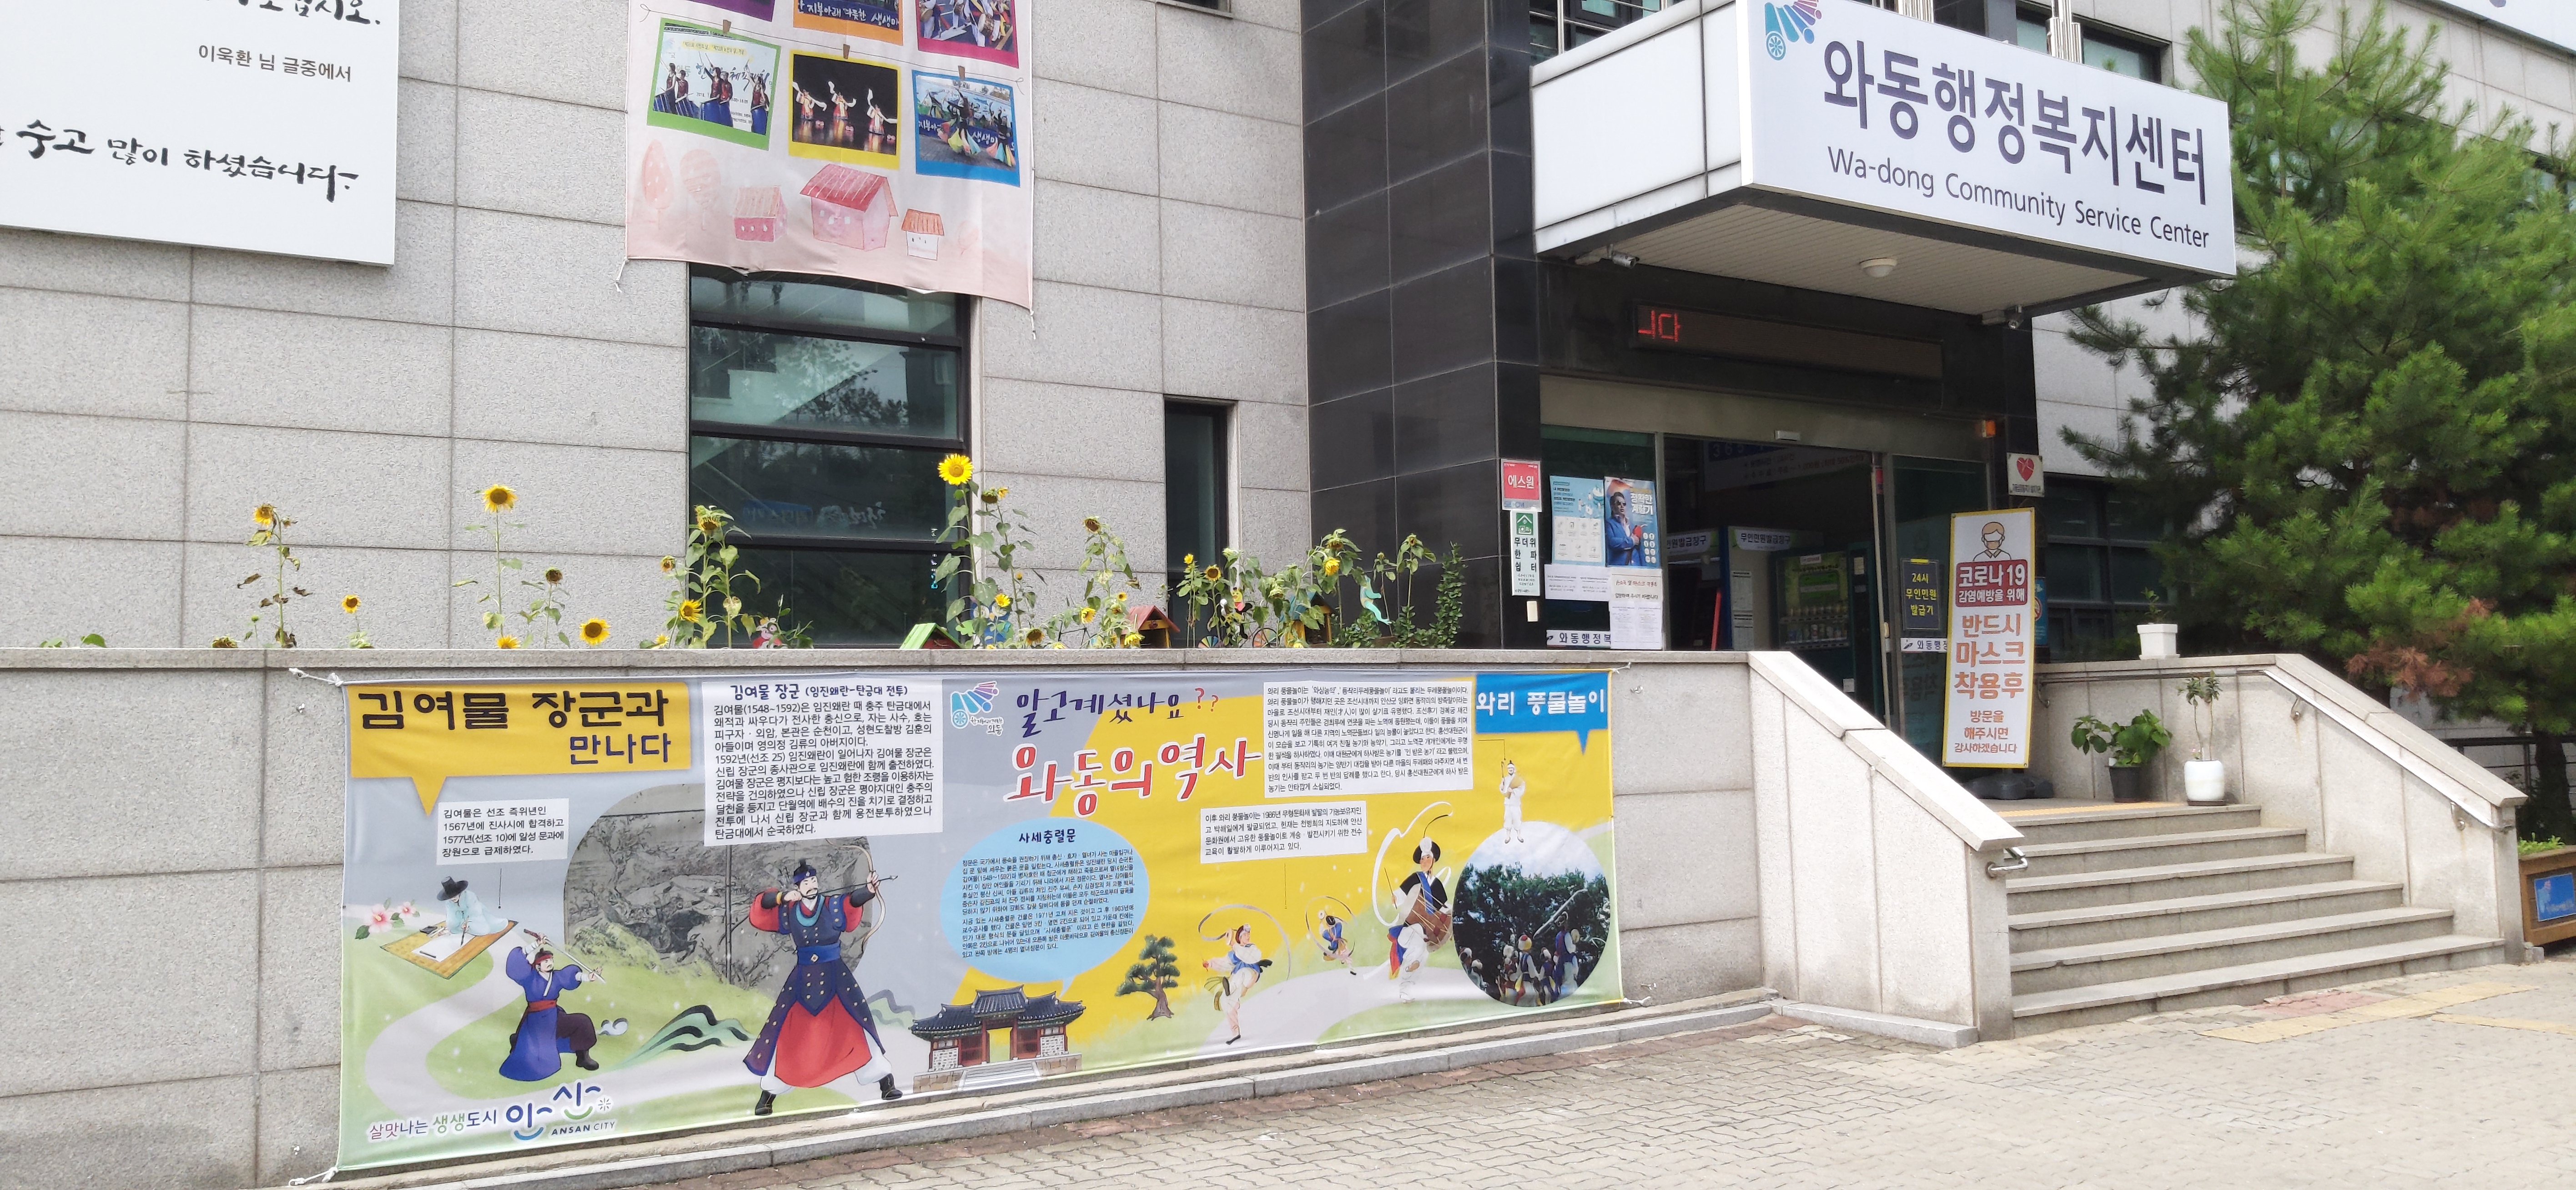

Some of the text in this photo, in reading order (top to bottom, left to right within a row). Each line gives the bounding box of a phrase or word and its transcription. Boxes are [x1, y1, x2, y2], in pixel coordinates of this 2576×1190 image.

[199, 45, 351, 82] 이욱환 님 글중에서
[1823, 40, 2206, 205] 와동행정복지센터
[107, 137, 168, 166] 많이
[1827, 146, 2210, 248] Wa-dong Community Service Center
[1508, 474, 1535, 489] 에스원
[1514, 537, 1536, 548] 무더위
[1740, 532, 1791, 545] 무인민원발급창구
[1912, 572, 1929, 584] 24시
[1959, 564, 2025, 588] 코로나 19
[1906, 588, 1937, 601] 무인민원
[1959, 589, 2004, 603] 감염예방을
[2006, 588, 2025, 602] 위해
[1910, 605, 1934, 617] 발급기
[1962, 613, 2021, 638] 반드시
[1956, 641, 2025, 667] 마스크
[730, 684, 770, 701] 김여물
[775, 684, 800, 700] 장군
[886, 685, 908, 697] 전투)
[1954, 672, 2024, 700] 착용후
[358, 689, 669, 730] 김여물 장군과
[813, 702, 851, 713] 임진왜란
[854, 702, 862, 711] 때
[865, 701, 884, 711] 충주
[886, 701, 931, 711] 탄금대에서
[1476, 689, 1605, 716] 와리 풍물놀이
[714, 716, 745, 728] 왜적과
[748, 716, 789, 726] 싸우다가
[792, 714, 821, 725] 전사한
[868, 713, 886, 723] 자는
[889, 712, 910, 723] 사수,
[913, 712, 932, 722] 호는
[1016, 688, 1184, 738] 알고계셨나요
[1970, 710, 2004, 723] 방문을
[714, 729, 745, 740] 피구자
[781, 726, 810, 738] 본관은
[856, 724, 902, 735] 성현도찰방
[906, 723, 931, 735] 김훈의
[1964, 727, 2008, 741] 해주시면
[569, 732, 671, 766] 만나다
[715, 736, 868, 752] 아들이며 영의정 김류의 아버지이다.
[1954, 742, 2017, 754] 감사하겠습니다
[715, 747, 932, 764] 1592년(선조 25) 임진왜란이 일어나자 김여물 장군은
[715, 759, 934, 777] 신립 장군의 종사관으로 임진왜란에 함께 출전하였다.
[1006, 736, 1263, 817] 와동의역사
[716, 771, 934, 790] 김여물 장군은 평지보다는 높고 험한 조령을 이용하자는
[716, 782, 932, 802] 전략을 건의하였으나 신립 장군은 평야지대인 충주의
[747, 802, 776, 814] 등지고
[818, 798, 845, 808] 배수의
[848, 797, 866, 807] 진을
[869, 796, 896, 806] 치기로
[898, 794, 933, 806] 결정하고
[444, 807, 546, 819] 김여물은 선조 즉위년인
[714, 815, 745, 827] 전투에
[751, 814, 770, 825] 나서
[775, 812, 794, 823] 신립
[799, 811, 829, 822] 장군과
[832, 809, 851, 820] 함께
[444, 818, 564, 831] 1567년에 진사시에 합격하고
[443, 834, 493, 844] 1577년(선조
[495, 832, 517, 842] 10)에
[538, 831, 564, 840] 문과에
[715, 827, 763, 840] 탄금대에서
[1019, 828, 1077, 844] 사세충렬문
[442, 845, 533, 857] 장원으로 급제하였다.
[370, 1119, 428, 1140] 살맛나는
[433, 1109, 497, 1134] 생생도시
[551, 1121, 615, 1136] ANSAN CITY
